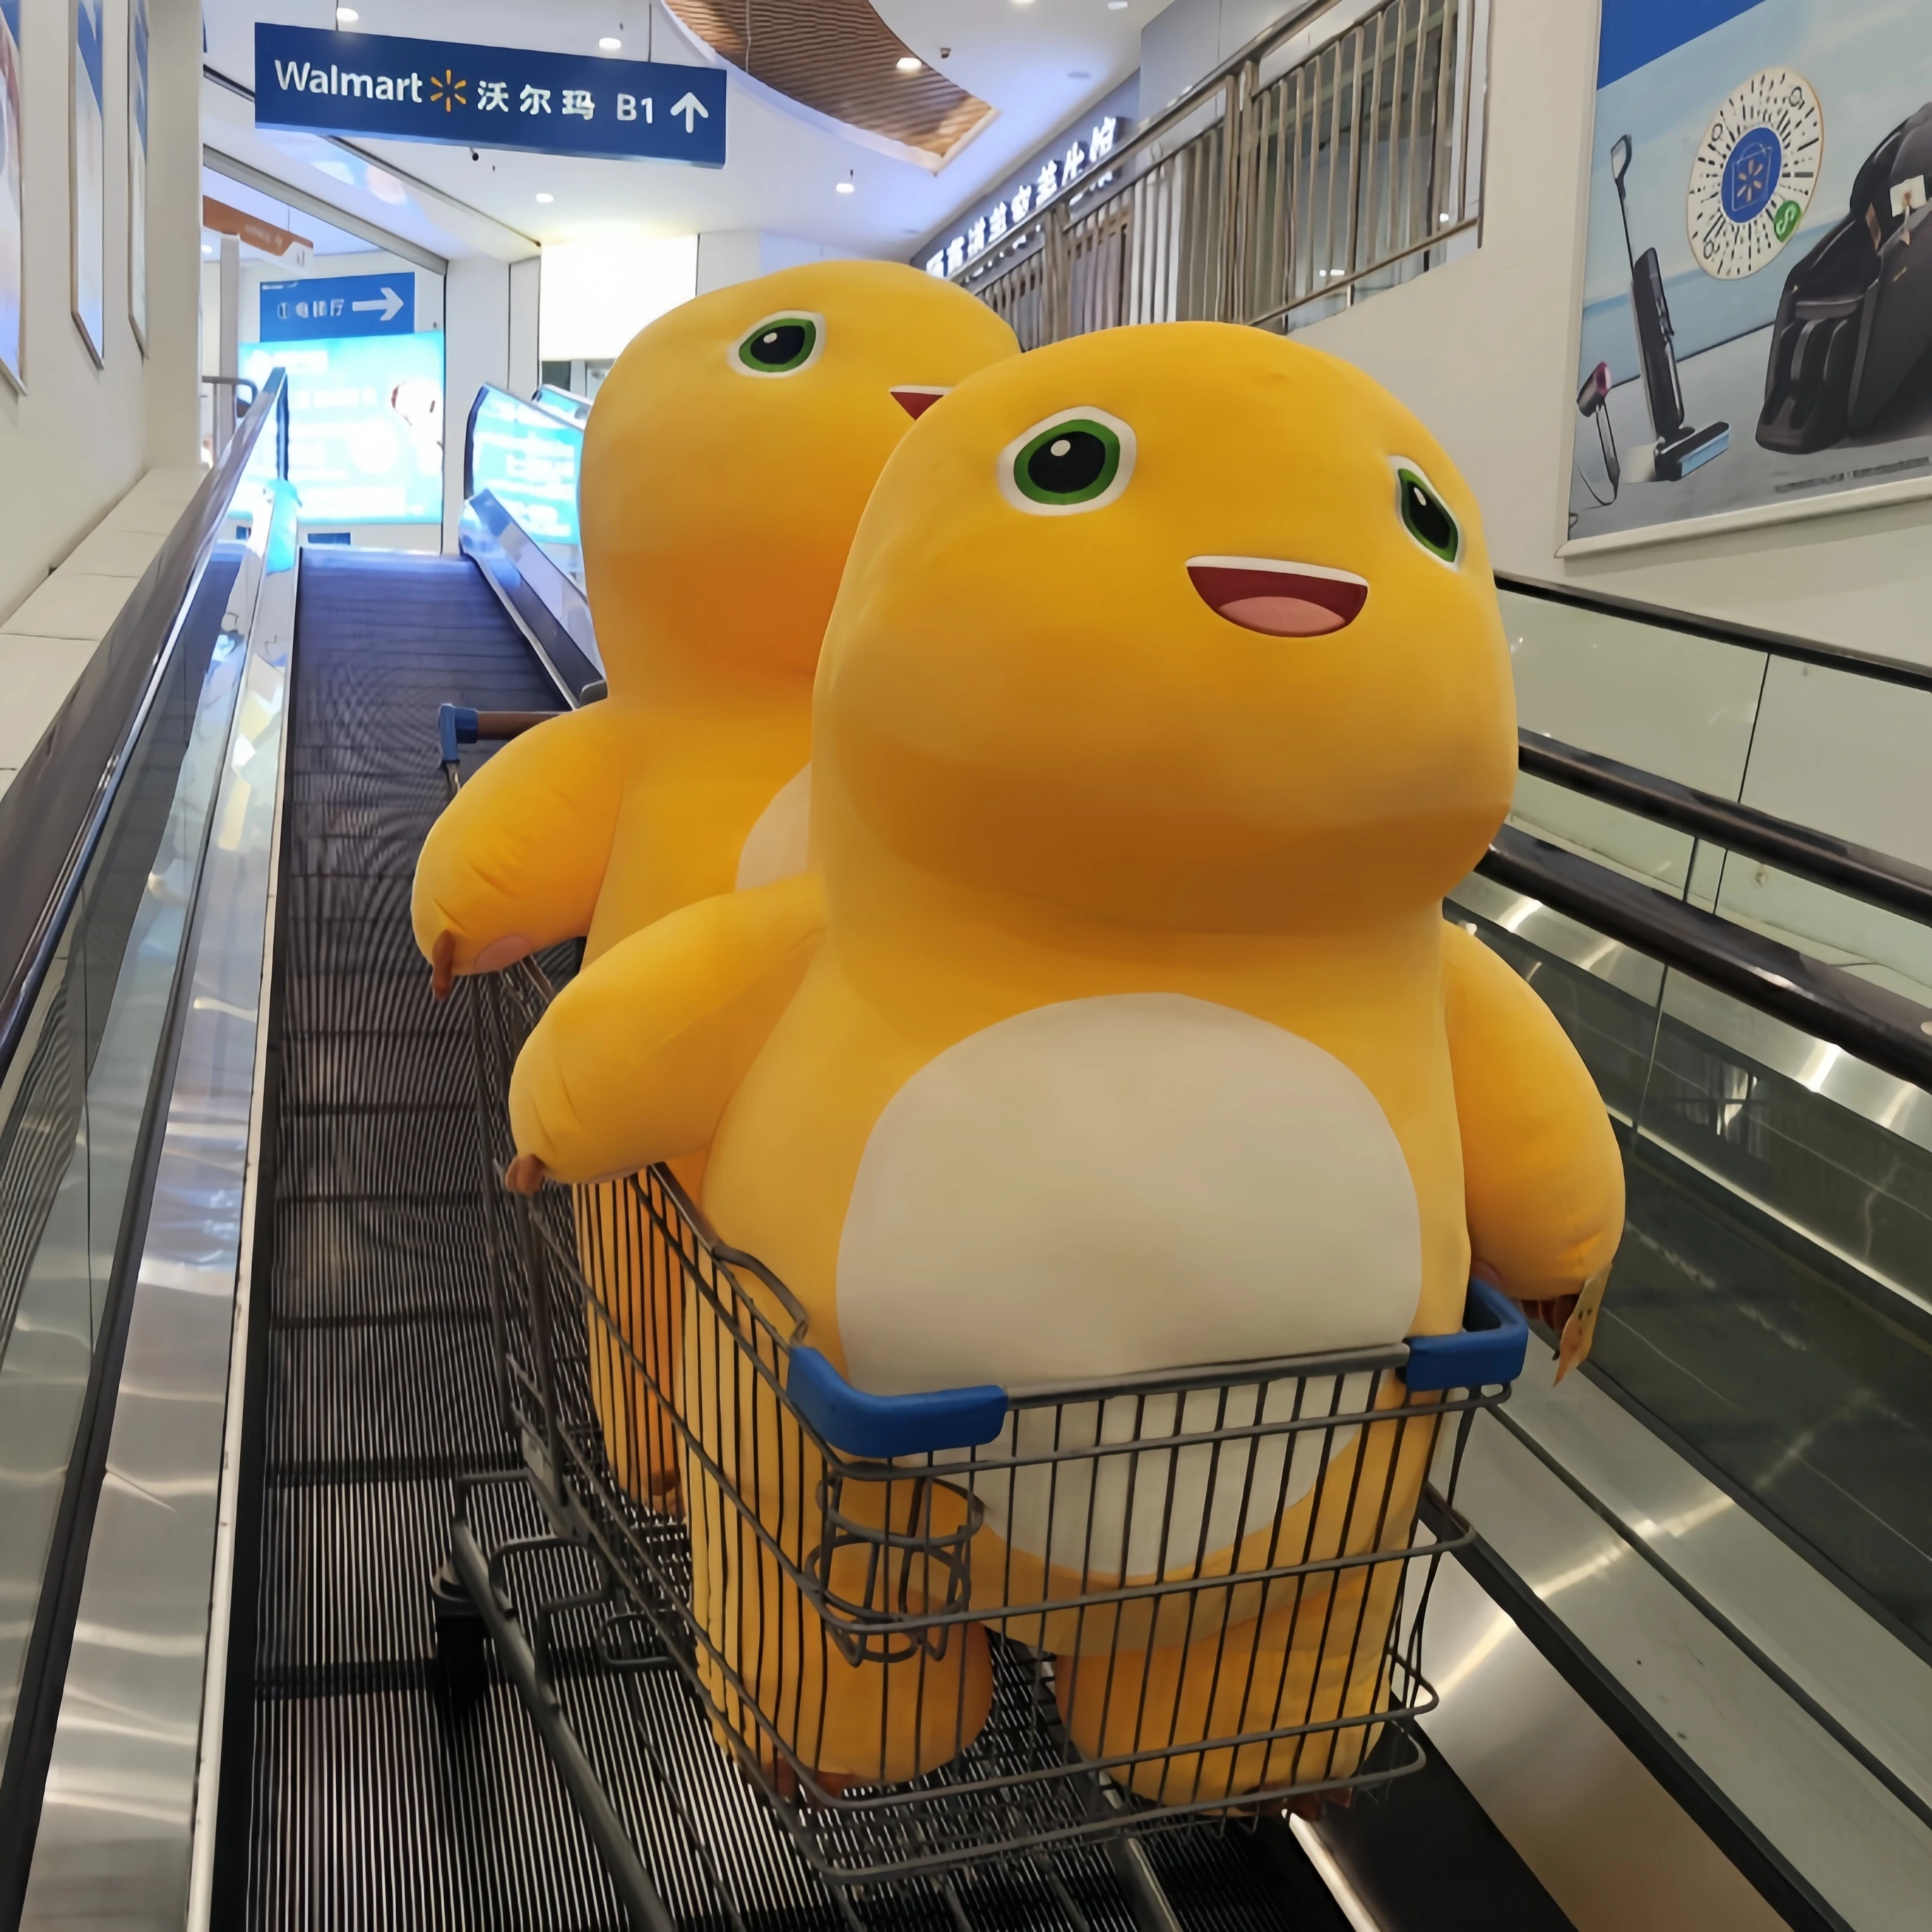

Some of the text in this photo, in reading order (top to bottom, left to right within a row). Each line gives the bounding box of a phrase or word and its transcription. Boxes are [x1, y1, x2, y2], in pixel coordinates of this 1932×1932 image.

[275, 60, 652, 124] Walmart 沃尔玛 B1
